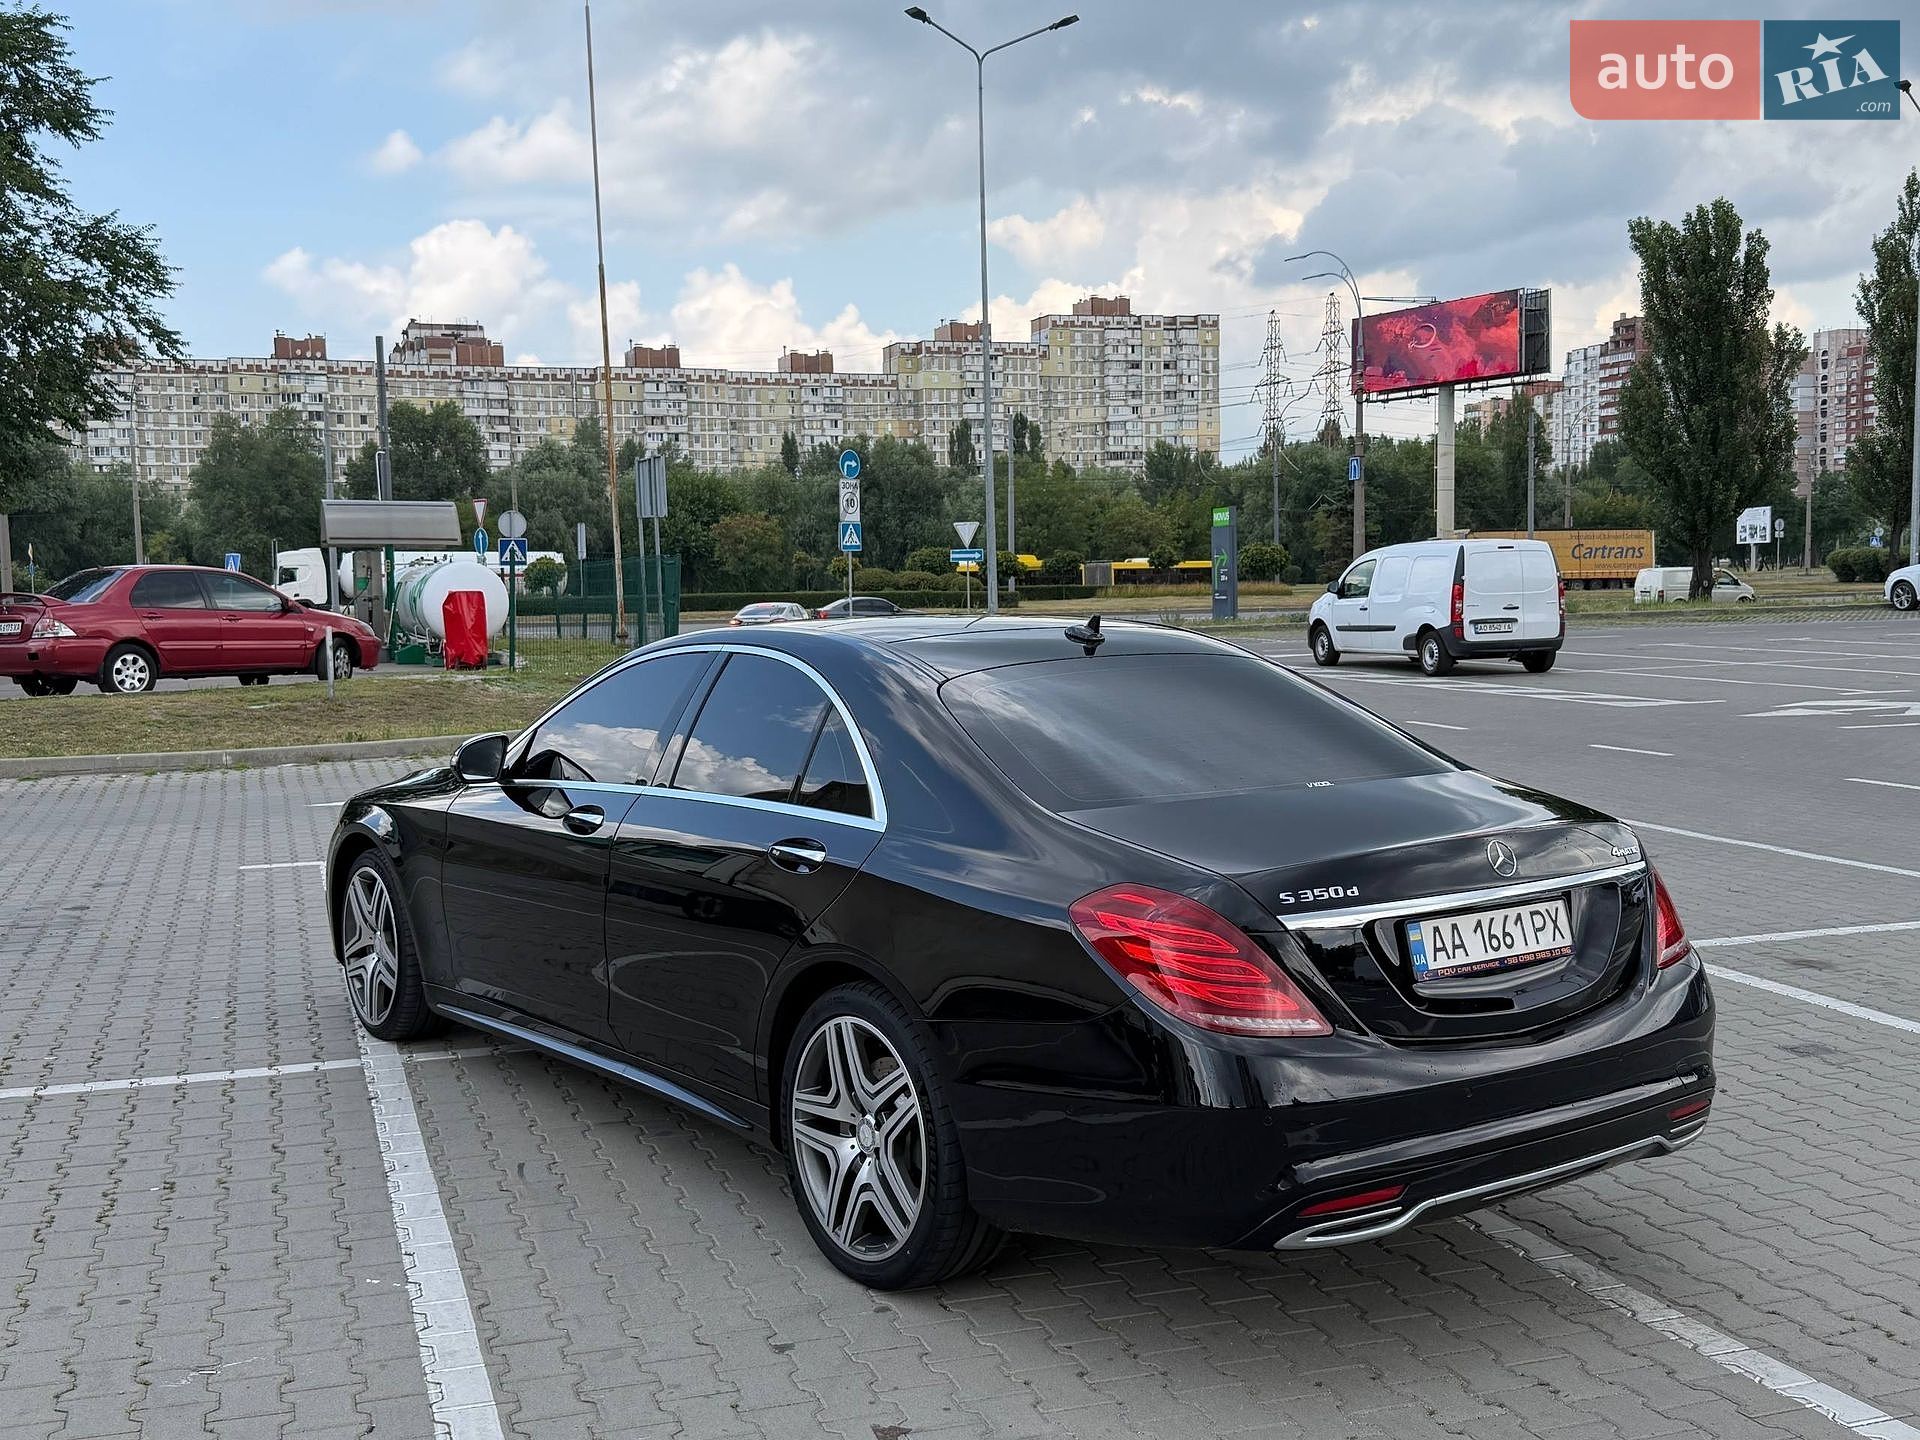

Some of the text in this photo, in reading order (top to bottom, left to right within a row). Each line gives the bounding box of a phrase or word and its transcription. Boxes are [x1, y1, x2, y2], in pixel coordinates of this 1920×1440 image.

[845, 498, 855, 508] 10
[1213, 511, 1230, 521] NOVUS
[1571, 543, 1645, 560] Cartrans
[1432, 922, 1469, 962] AA
[1413, 953, 1427, 966] UA
